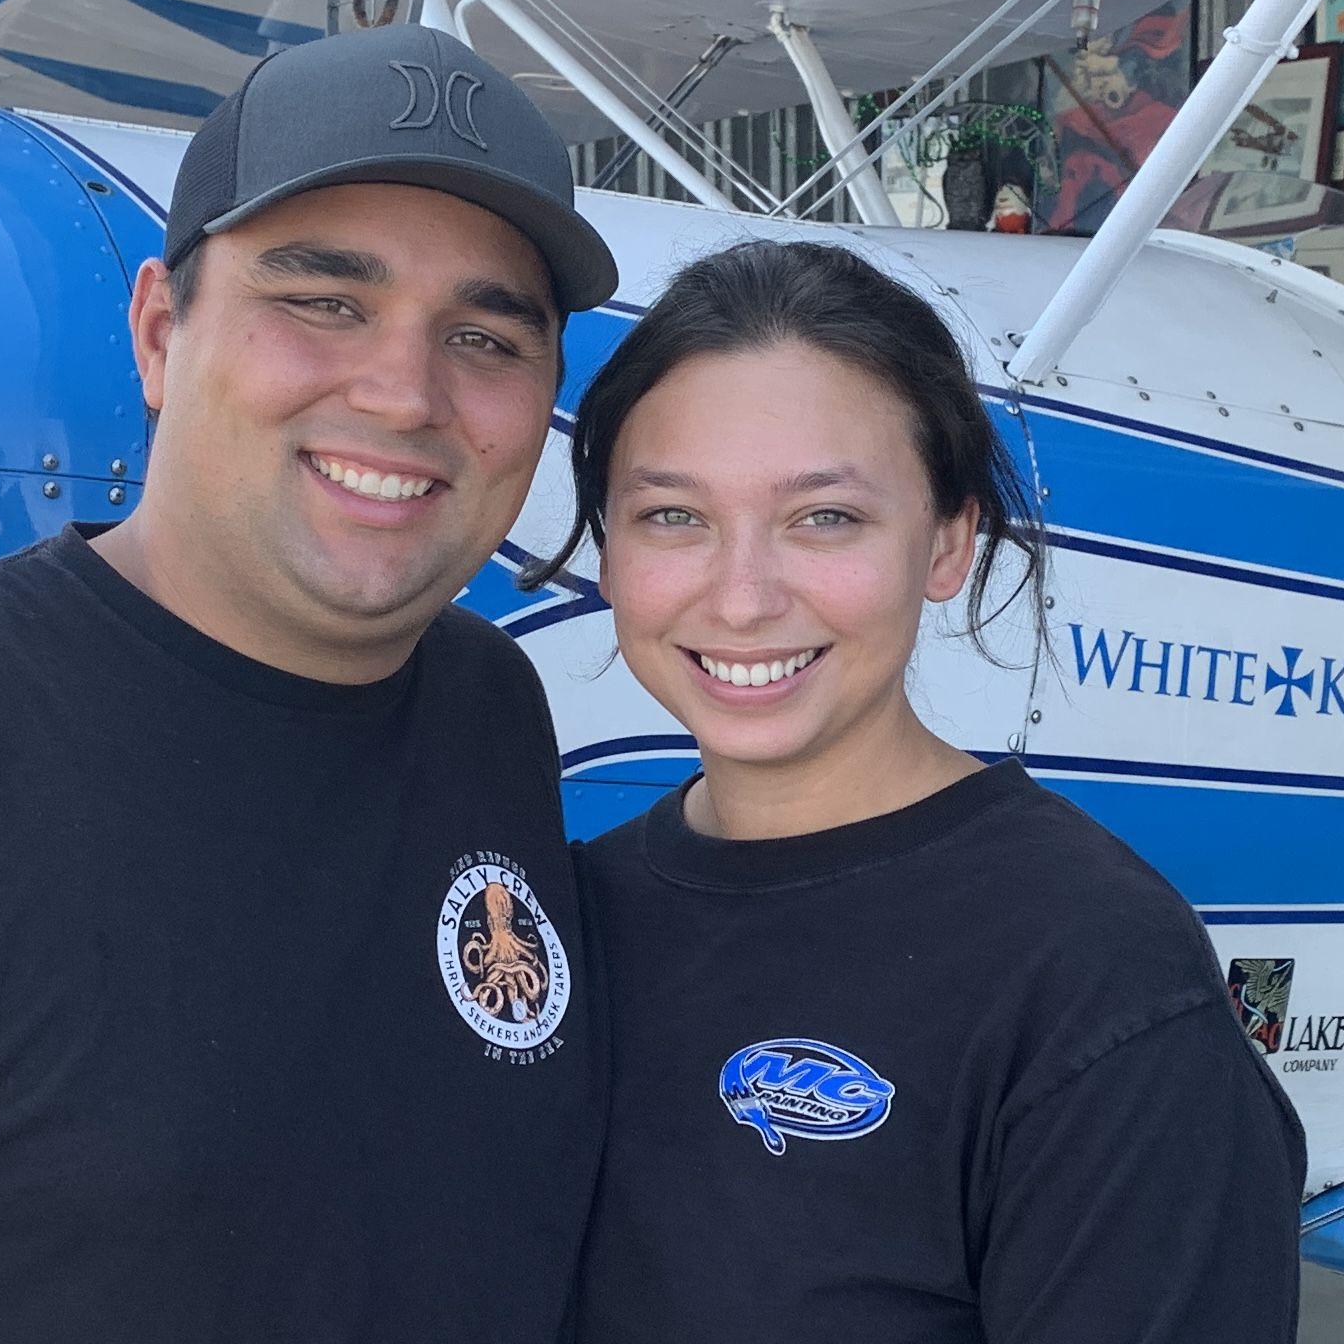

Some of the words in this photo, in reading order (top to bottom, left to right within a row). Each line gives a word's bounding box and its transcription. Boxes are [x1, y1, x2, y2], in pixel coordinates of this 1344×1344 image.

[1067, 622, 1258, 707] WHITE
[441, 867, 488, 930] SALTY
[499, 870, 548, 926] CREW
[551, 942, 564, 996] TAKERS
[467, 1006, 520, 1042] SEEKERS
[543, 1003, 561, 1030] RISK
[523, 1025, 543, 1042] AND
[1283, 1058, 1338, 1073] COMPANY
[758, 1092, 848, 1121] PAINTING
